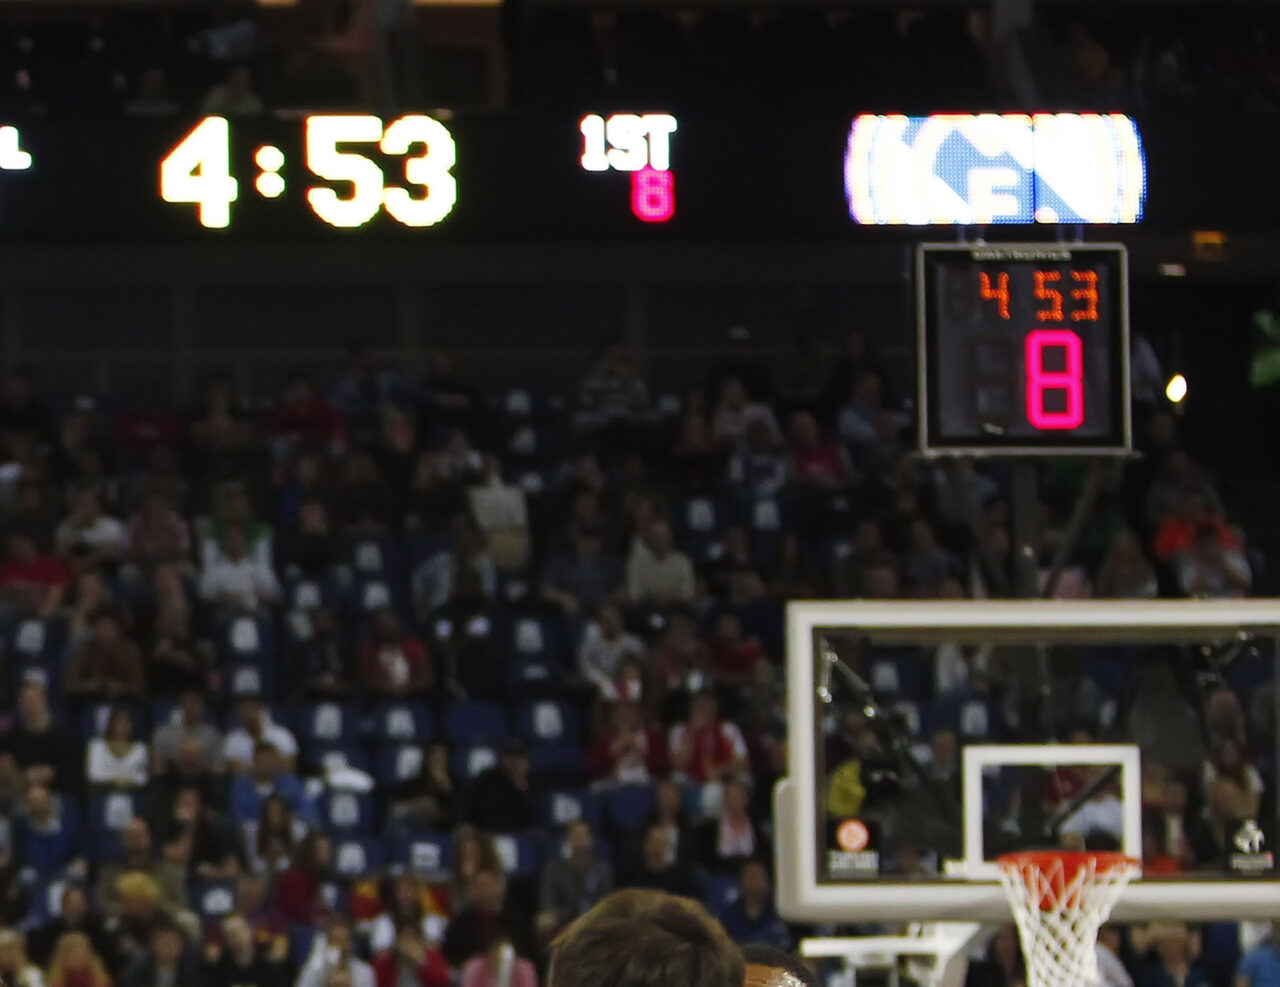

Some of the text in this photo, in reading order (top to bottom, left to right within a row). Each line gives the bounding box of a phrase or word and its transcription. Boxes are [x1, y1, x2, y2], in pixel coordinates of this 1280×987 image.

[158, 112, 458, 229] 4:53
[578, 112, 678, 171] 1ST
[631, 169, 675, 223] 8
[979, 268, 1100, 322] 4 53
[1024, 329, 1085, 430] 8
